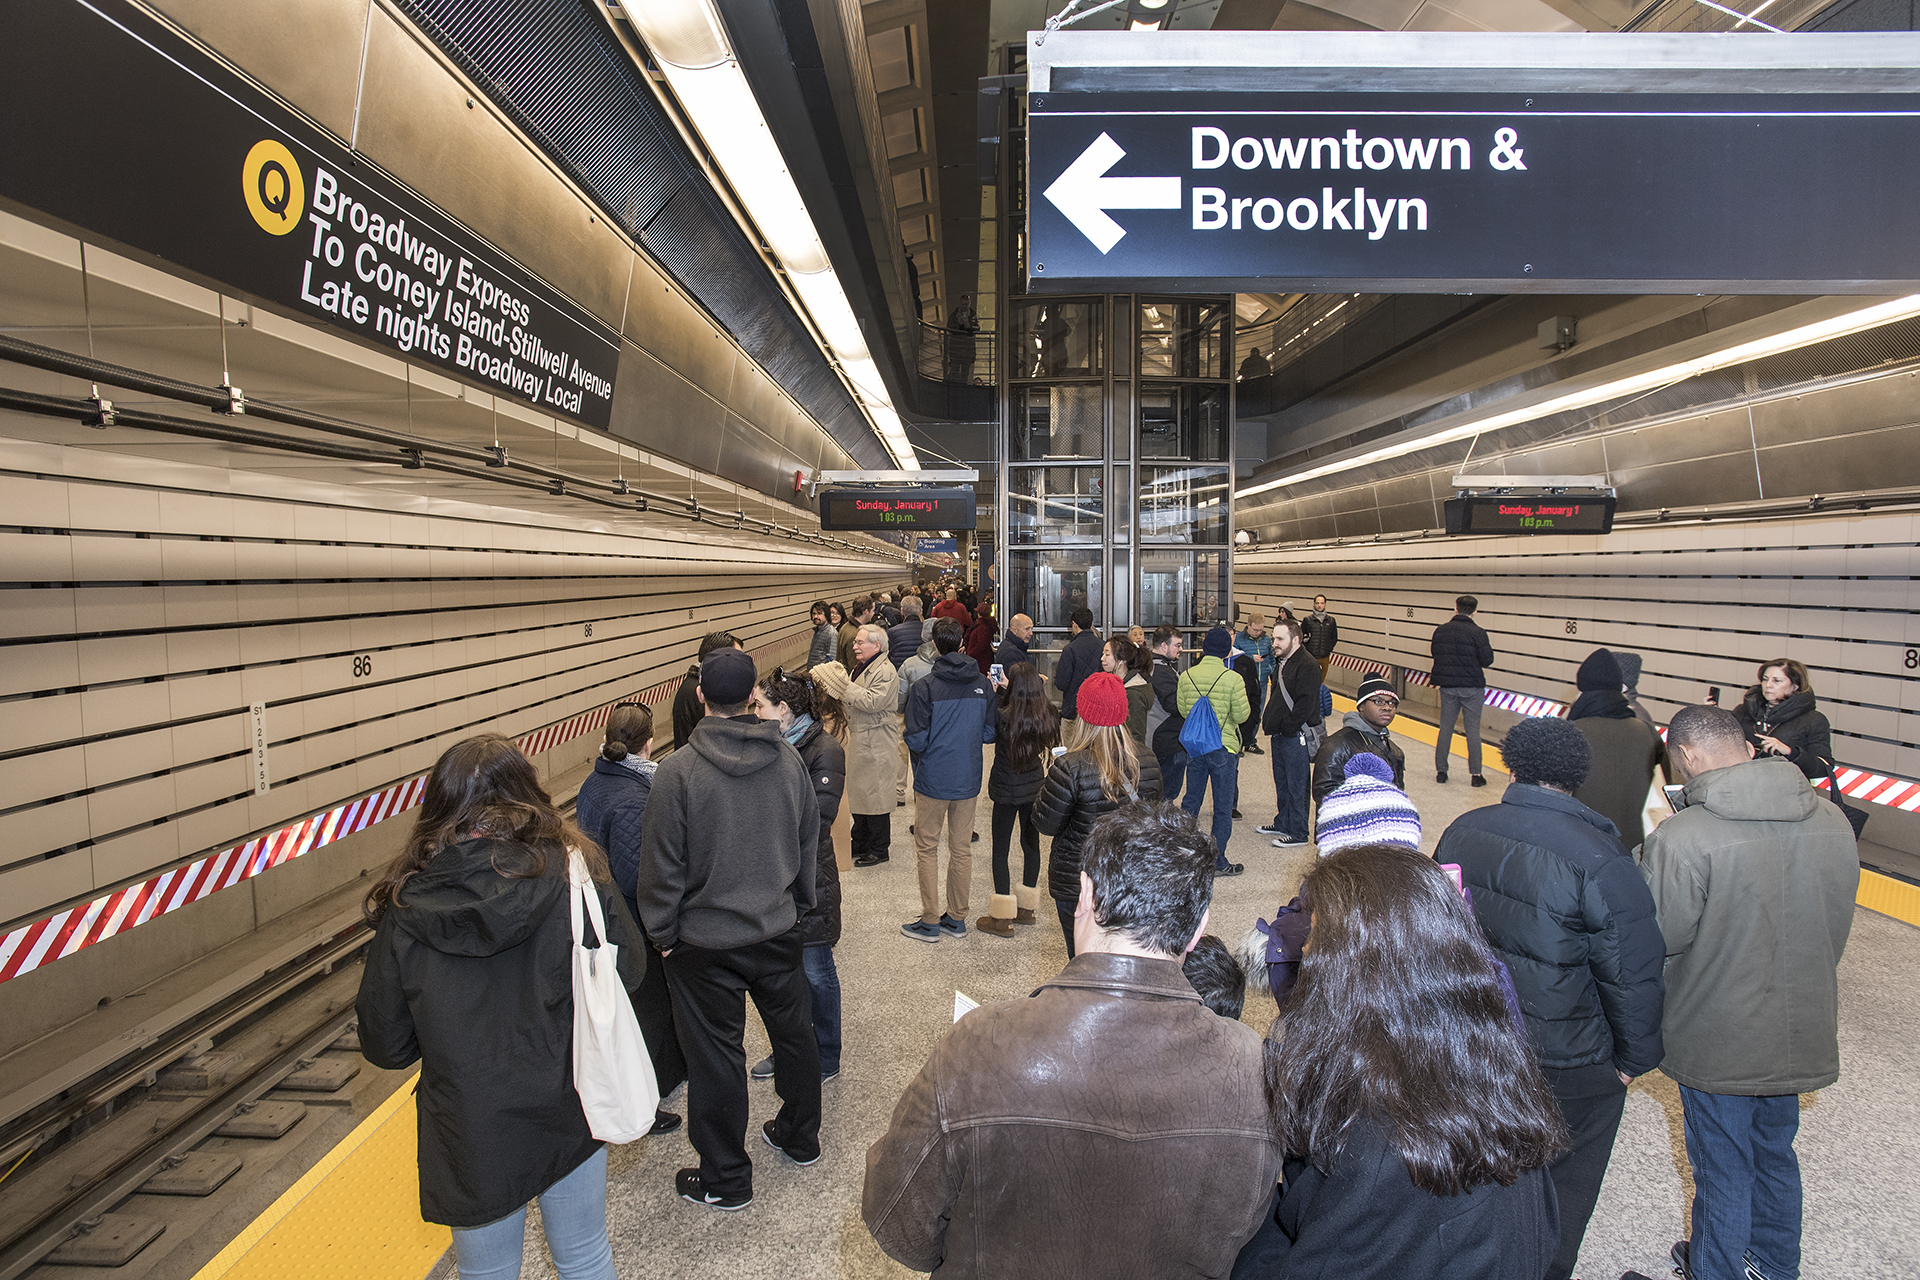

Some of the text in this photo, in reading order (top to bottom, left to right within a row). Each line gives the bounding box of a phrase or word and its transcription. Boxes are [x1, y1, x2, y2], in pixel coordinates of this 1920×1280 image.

[1191, 127, 1528, 171] Downtown &
[258, 160, 291, 221] Q
[1191, 187, 1428, 241] Brooklyn
[312, 167, 531, 327] Broadway Express
[309, 213, 612, 400] To Coney Island-Stillwell Avenue
[300, 260, 583, 415] Late nights Broadway Local
[856, 500, 938, 512] Sunday, January 1
[1498, 505, 1580, 517] Sunday, January 1
[584, 623, 593, 638] 86
[1565, 620, 1578, 635] 86
[353, 654, 372, 678] 86
[1904, 649, 1920, 669] 8
